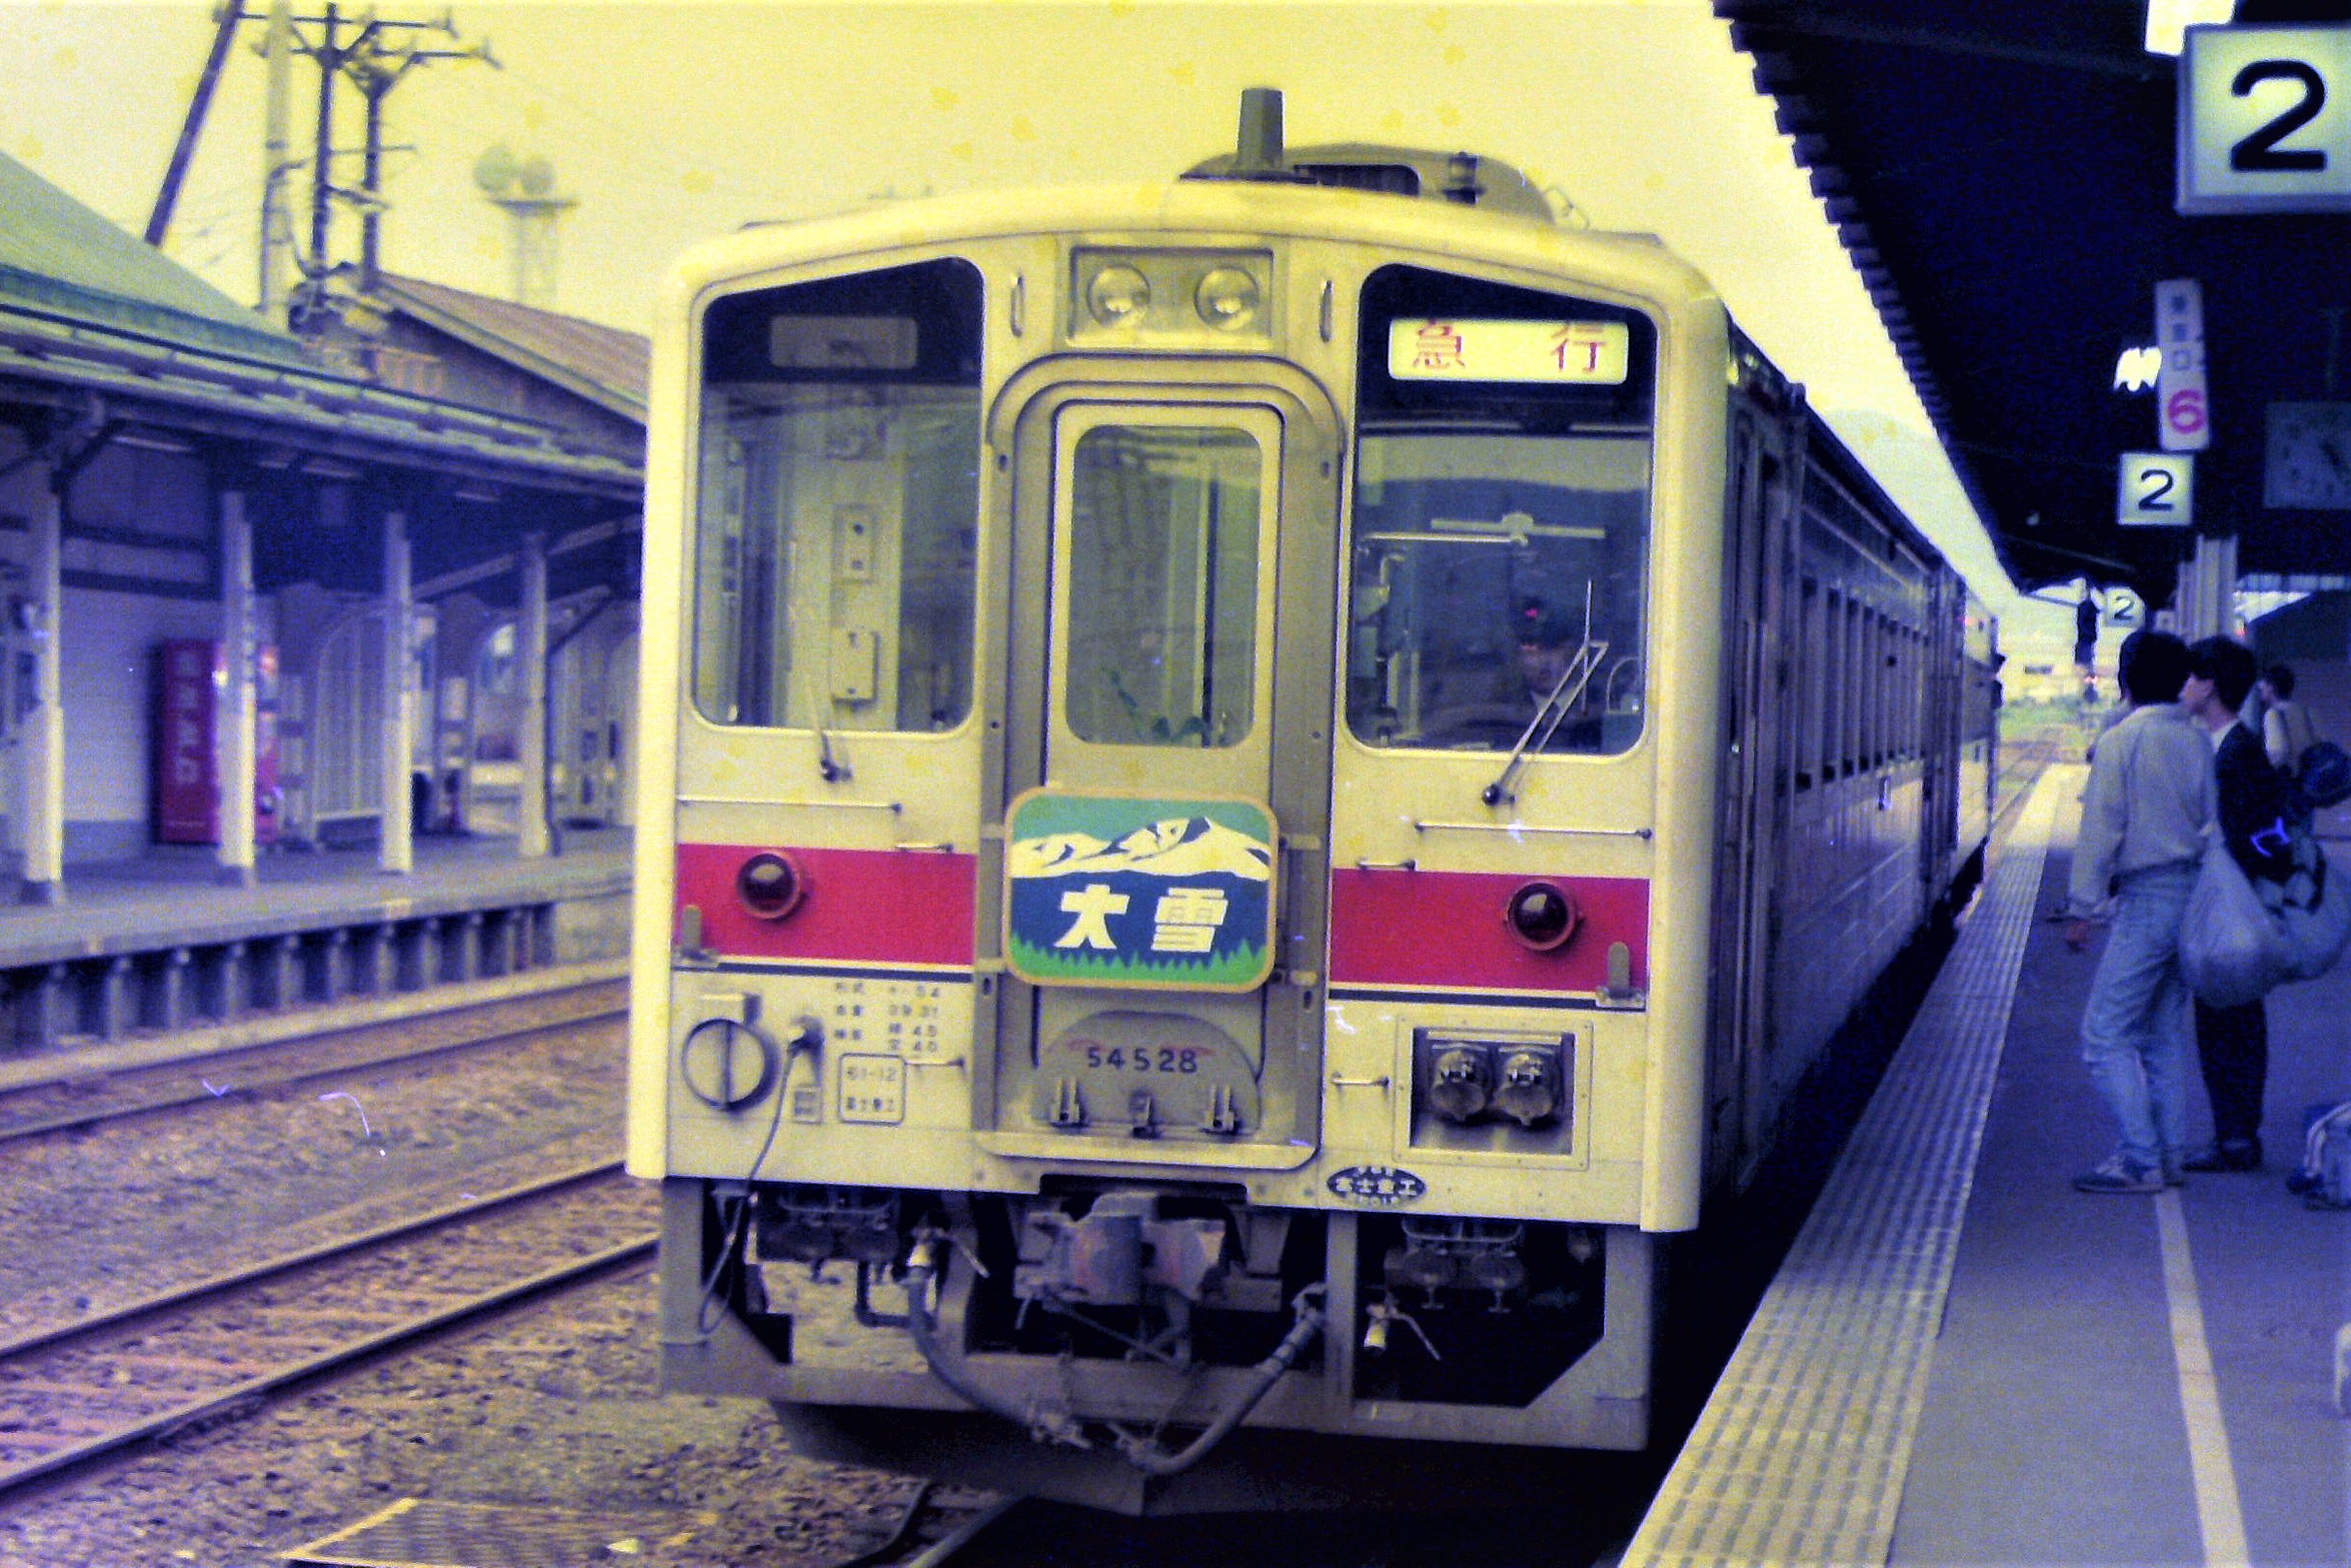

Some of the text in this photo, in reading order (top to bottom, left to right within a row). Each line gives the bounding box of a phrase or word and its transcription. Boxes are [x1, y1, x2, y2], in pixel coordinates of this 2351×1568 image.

[2231, 59, 2328, 173] 2
[1412, 317, 1608, 373] 急行
[2167, 389, 2205, 435] 6
[2138, 468, 2174, 511] 2
[2113, 595, 2137, 621] 2
[1053, 883, 1229, 952] 大雪
